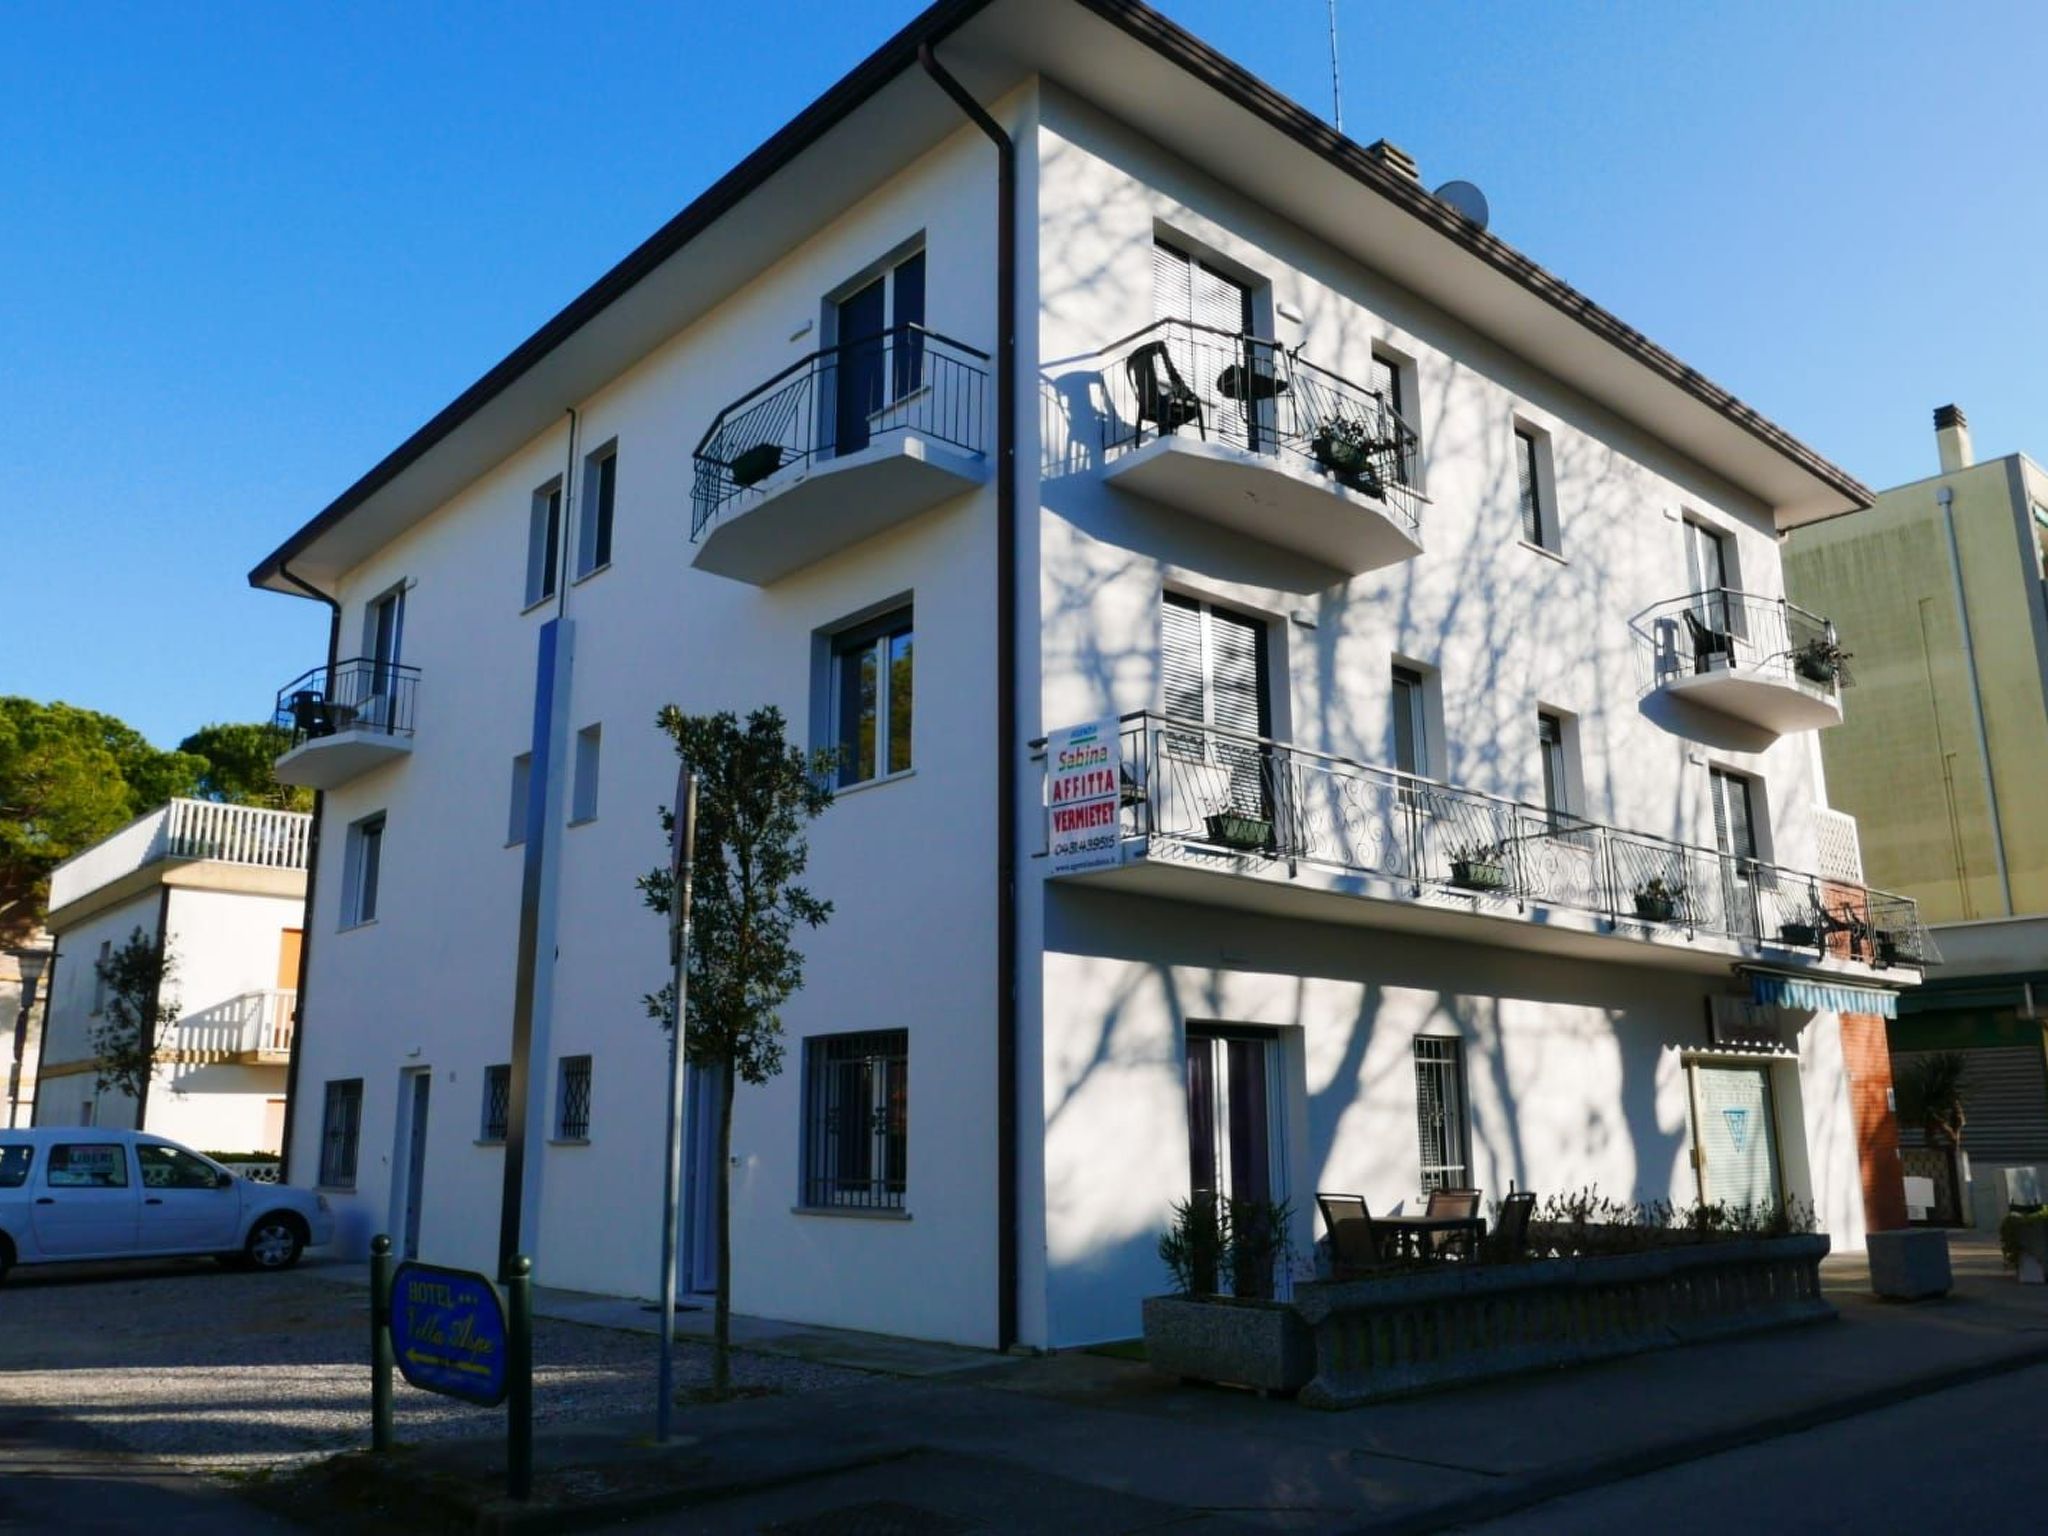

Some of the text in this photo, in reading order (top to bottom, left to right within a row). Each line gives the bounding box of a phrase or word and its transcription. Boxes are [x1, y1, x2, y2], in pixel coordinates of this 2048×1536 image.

[1059, 745, 1108, 771] Sabina
[1053, 769, 1115, 802] AFFITTA
[1053, 801, 1115, 833] VERMIETET
[408, 1280, 454, 1310] HOTEL
